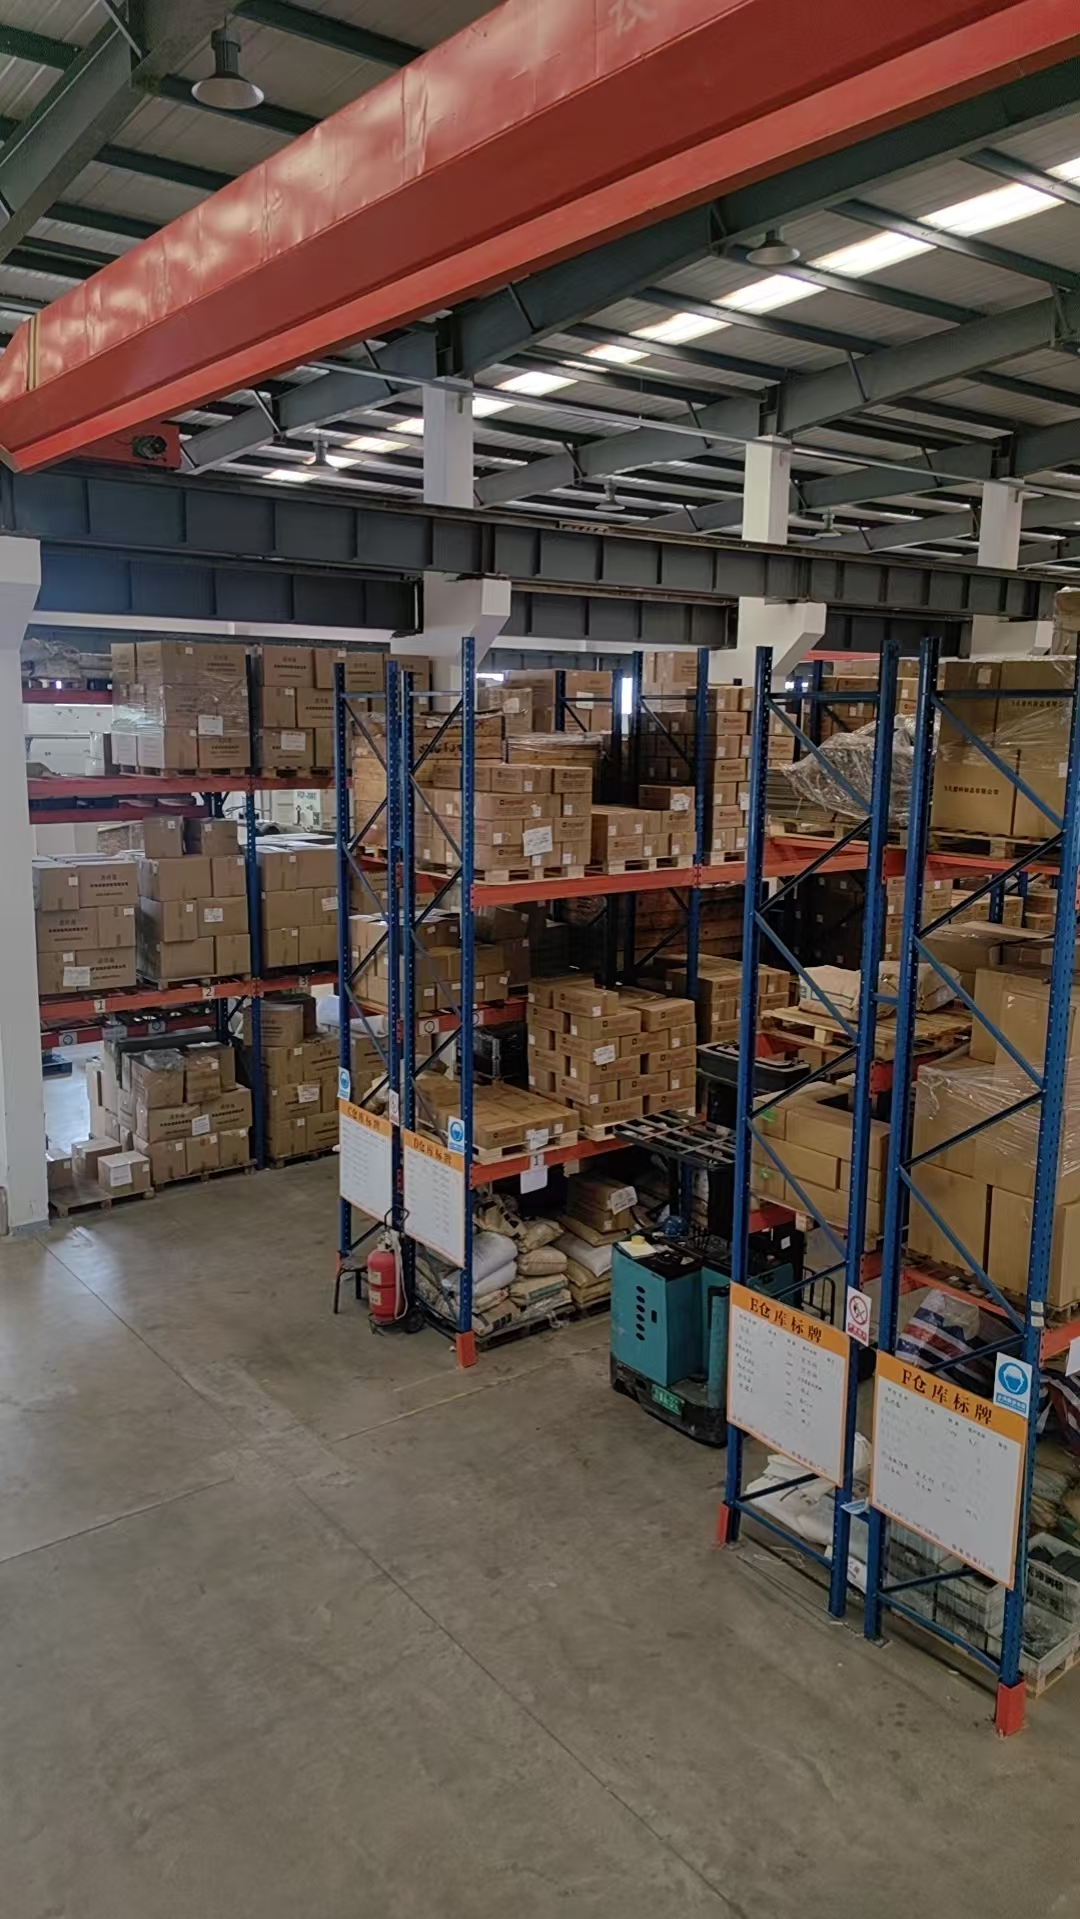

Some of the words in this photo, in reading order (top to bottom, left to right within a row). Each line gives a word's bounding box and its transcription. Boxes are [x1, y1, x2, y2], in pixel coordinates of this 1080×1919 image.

[205, 987, 212, 997] 2
[750, 1297, 822, 1344] E仓库标牌
[901, 1368, 993, 1425] F仓库标牌
